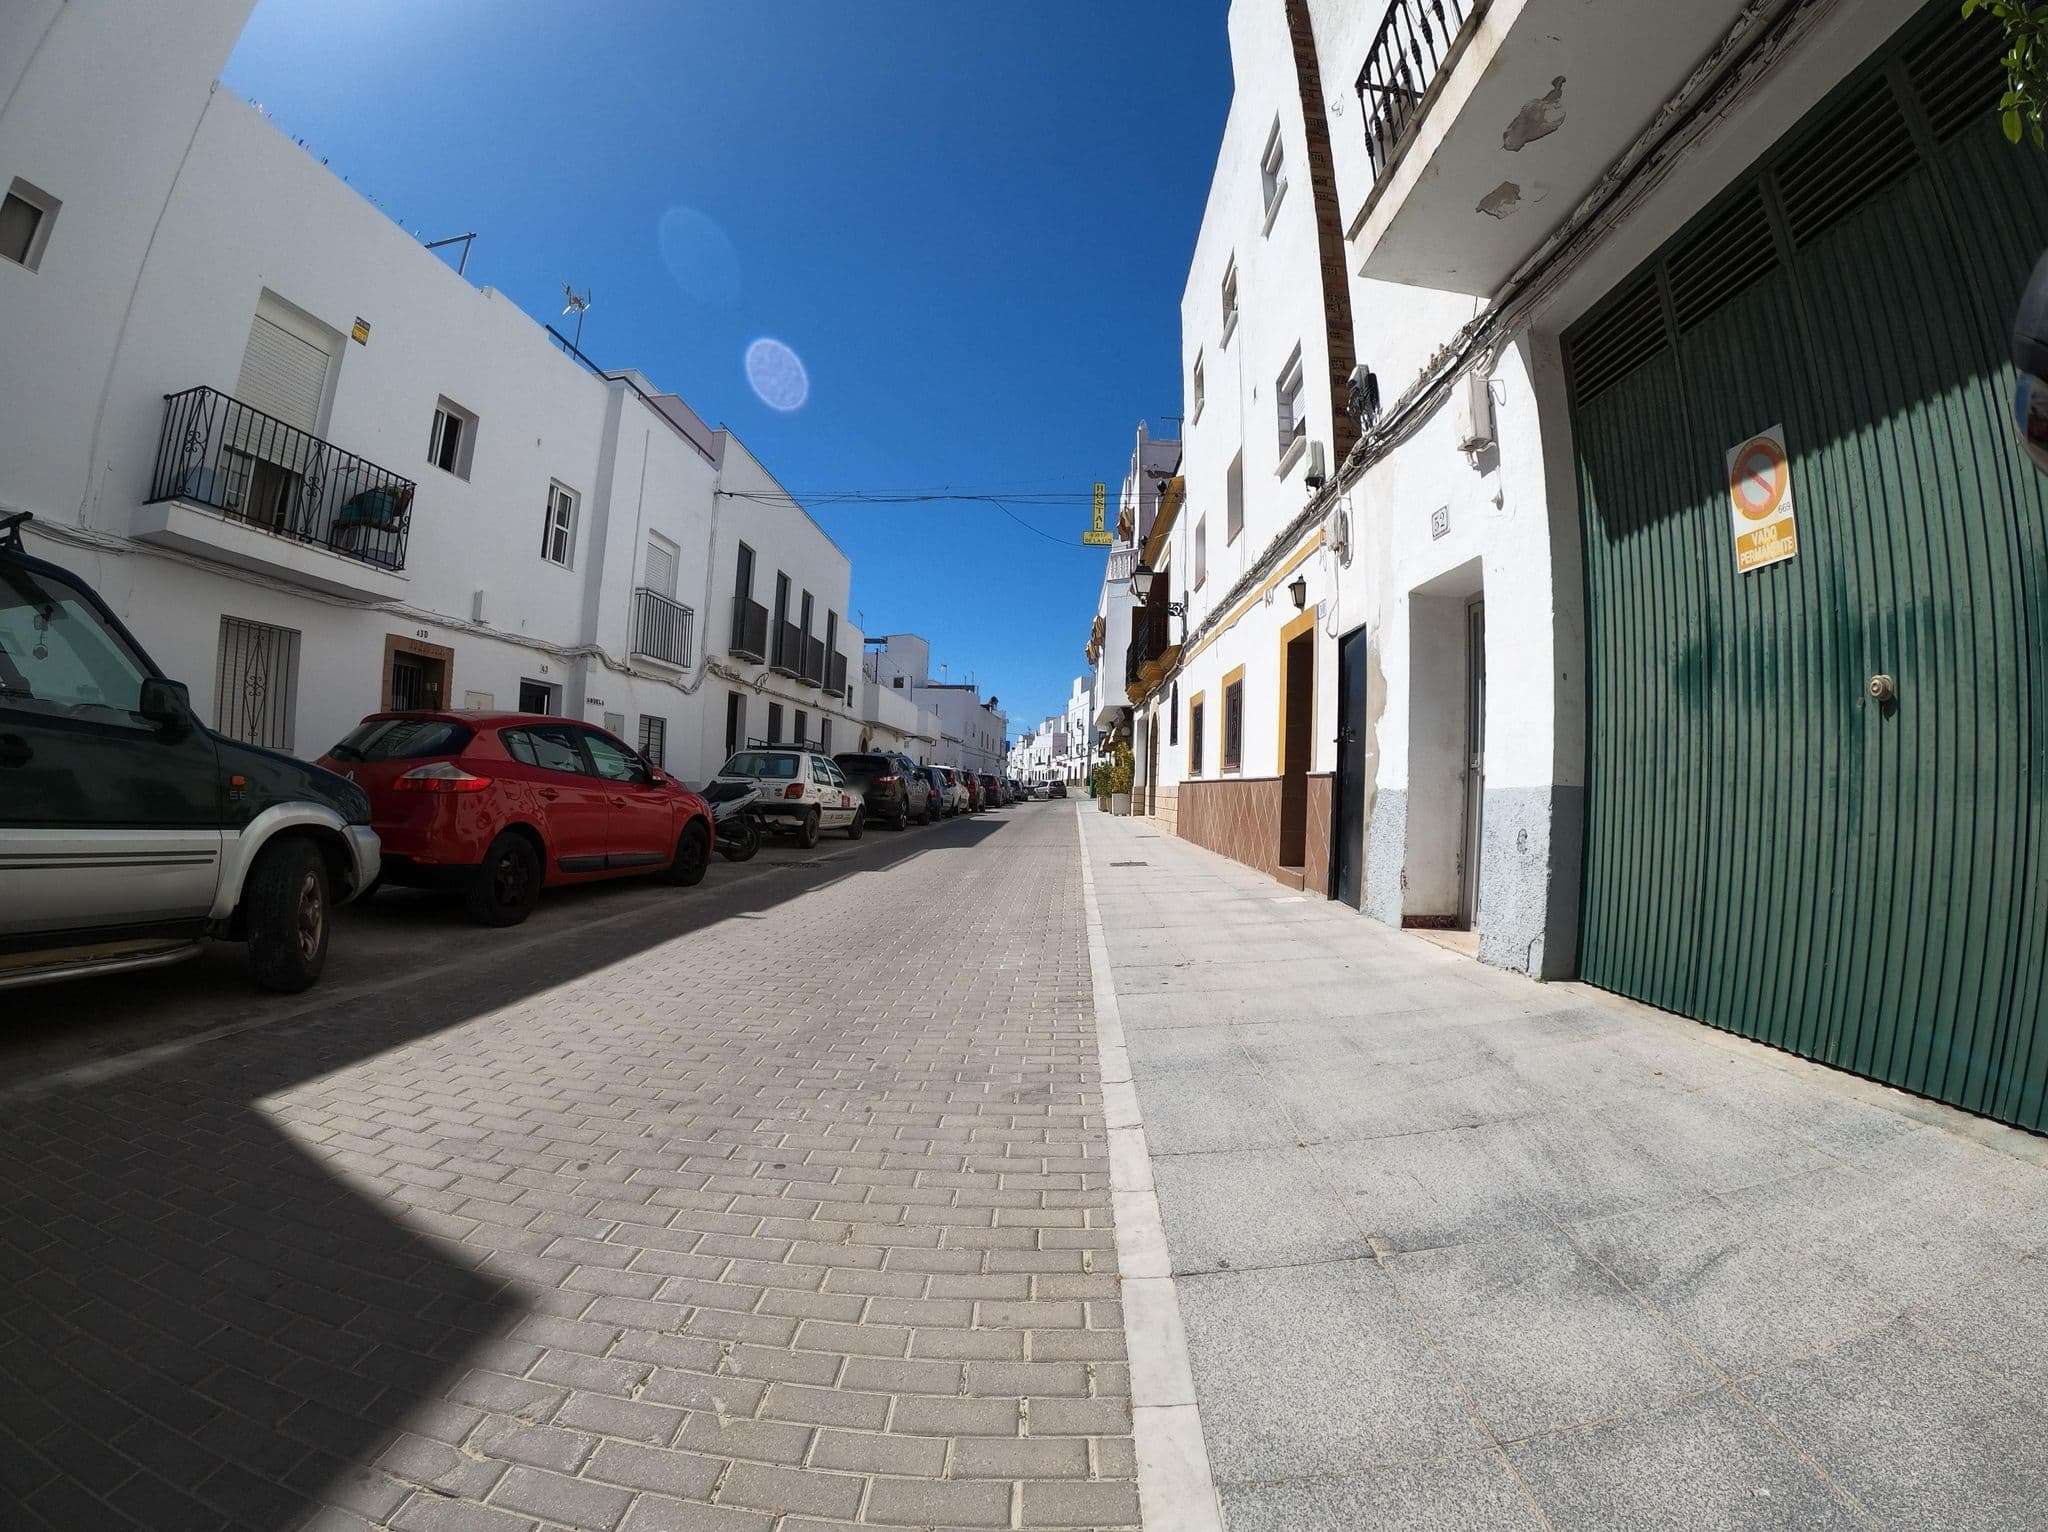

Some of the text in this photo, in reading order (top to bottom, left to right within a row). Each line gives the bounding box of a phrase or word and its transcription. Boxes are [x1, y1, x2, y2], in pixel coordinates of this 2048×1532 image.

[1095, 484, 1104, 530] HOSTAL
[1778, 501, 1791, 514] 669
[1434, 512, 1446, 532] 52
[1751, 525, 1778, 545] VADO
[229, 790, 249, 800] SE
